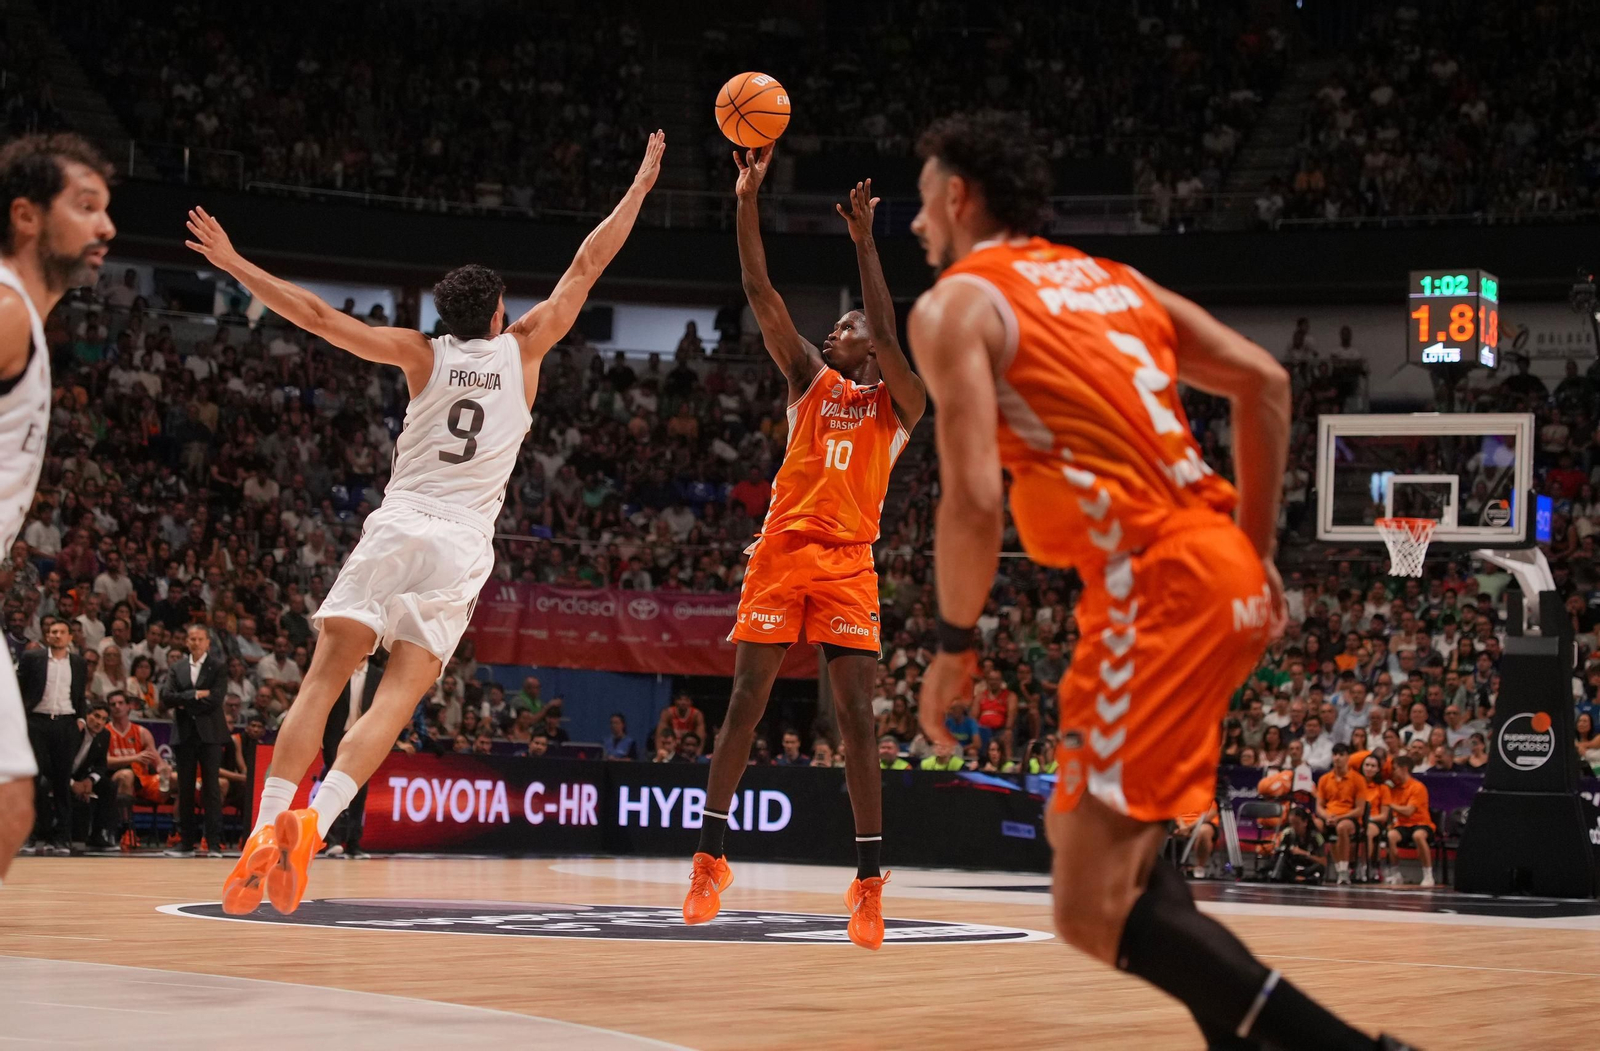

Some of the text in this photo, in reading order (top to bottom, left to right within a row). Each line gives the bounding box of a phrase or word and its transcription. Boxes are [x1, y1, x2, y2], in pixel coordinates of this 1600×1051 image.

[1420, 274, 1469, 296] 1:02
[1411, 303, 1475, 343] 1.8
[1479, 305, 1498, 348] 1.8
[1422, 350, 1461, 363] LOTUS
[448, 369, 502, 390] PROCIDA
[1105, 329, 1185, 435] 2
[820, 399, 877, 419] VALENCIA
[438, 398, 485, 465] 9
[825, 439, 853, 470] 10
[535, 595, 615, 618] endesa
[751, 611, 783, 624] PULEV
[837, 622, 869, 637] Midea
[388, 776, 510, 823] TOYOTA
[523, 781, 599, 826] C-HR
